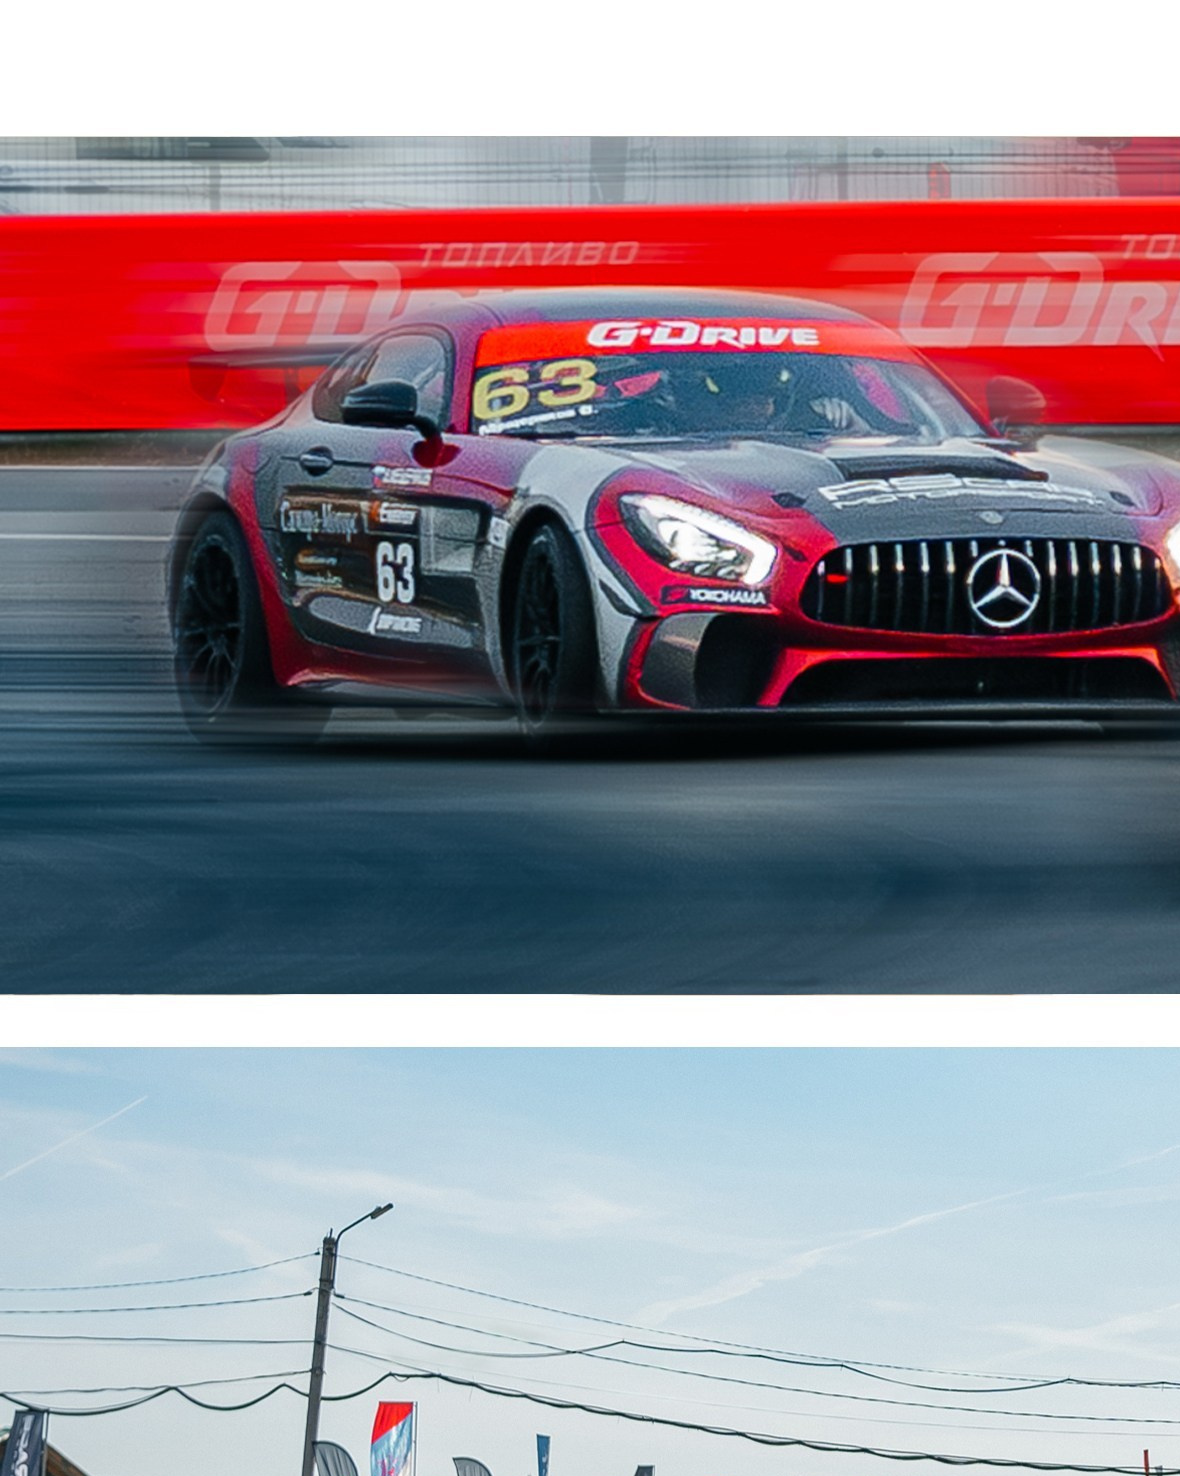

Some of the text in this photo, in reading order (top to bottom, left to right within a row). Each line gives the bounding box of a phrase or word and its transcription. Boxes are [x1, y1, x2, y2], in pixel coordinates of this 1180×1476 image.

[420, 241, 639, 269] ТОПЛИВО
[473, 358, 598, 421] 63
[376, 541, 415, 603] 63
[690, 588, 766, 604] YOKOHAMA
